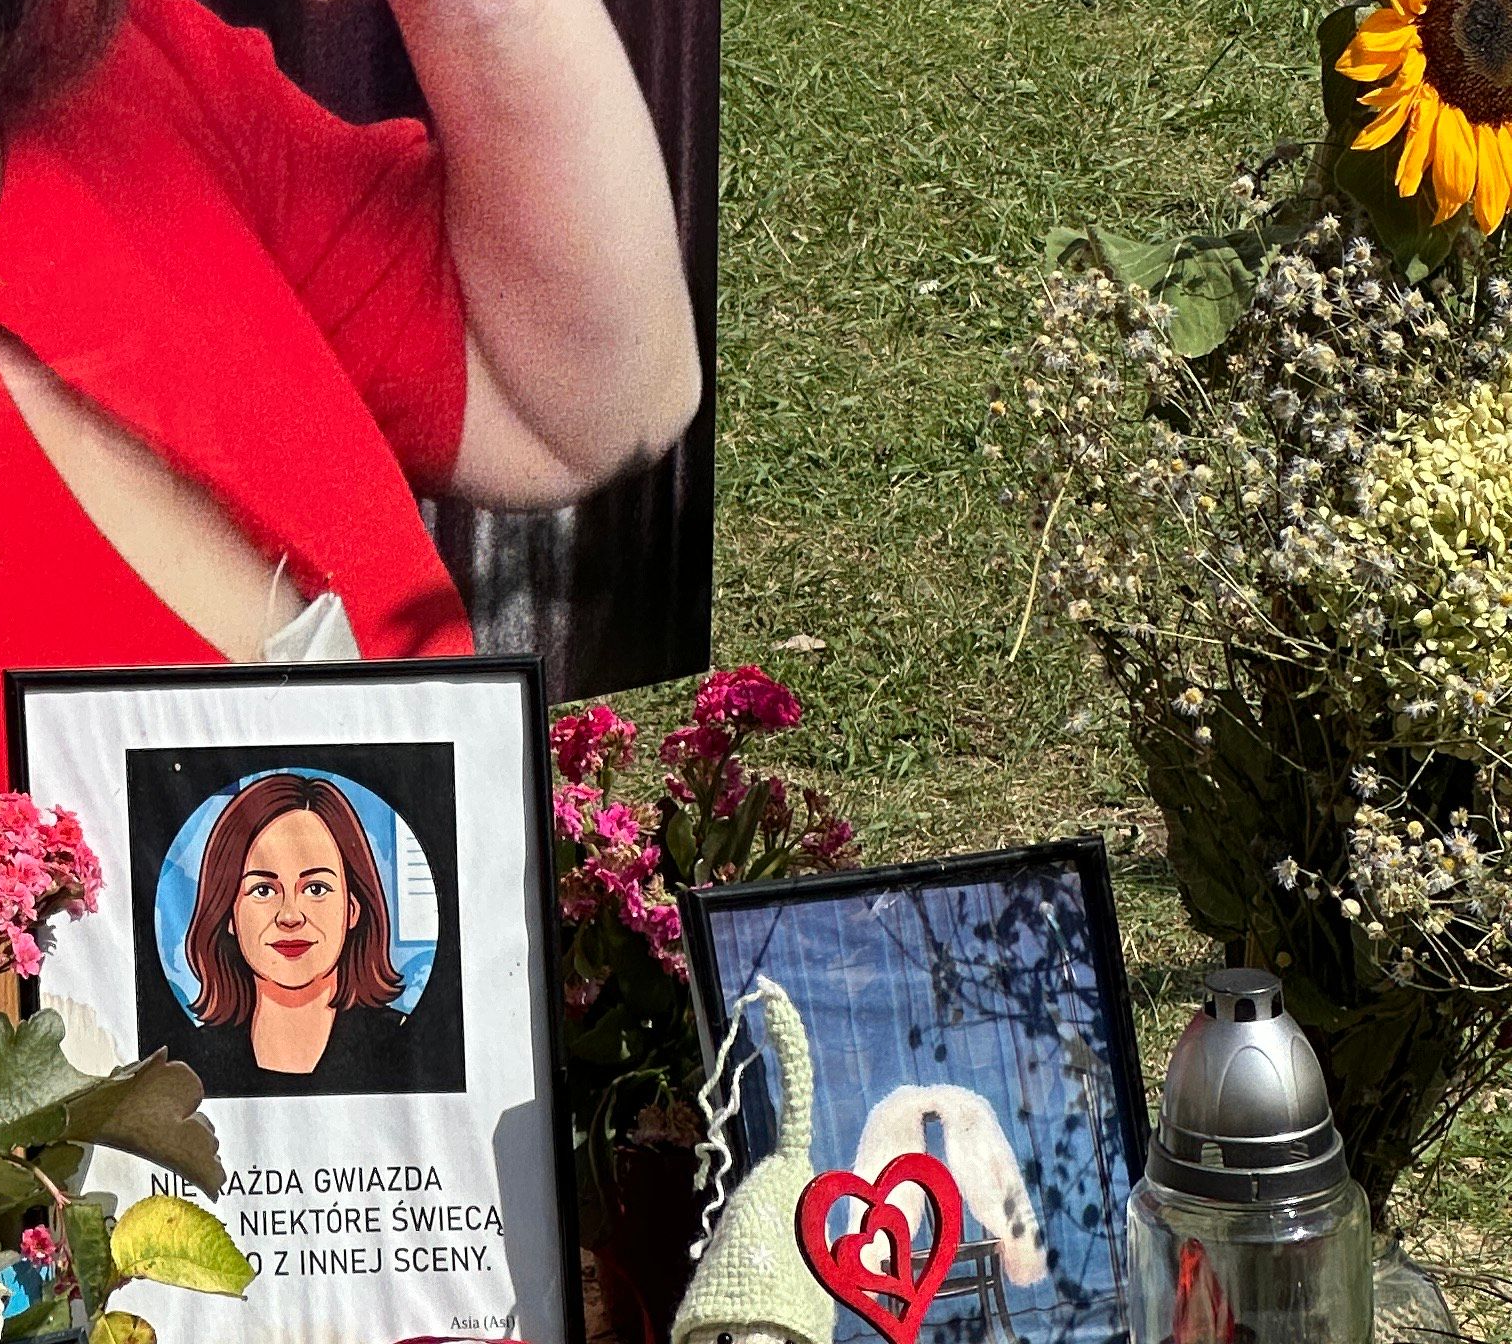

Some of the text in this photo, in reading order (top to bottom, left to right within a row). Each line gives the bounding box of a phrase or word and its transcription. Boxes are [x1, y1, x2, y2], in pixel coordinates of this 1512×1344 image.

[314, 1165, 443, 1193] GWIAZDA
[240, 1201, 381, 1237] NIEKTÓRE
[392, 1200, 505, 1237] ŚWIECĄ
[274, 1250, 290, 1276] Z
[300, 1247, 382, 1276] INNEJ
[394, 1245, 492, 1273] SCENY.
[450, 1315, 479, 1331] Asia
